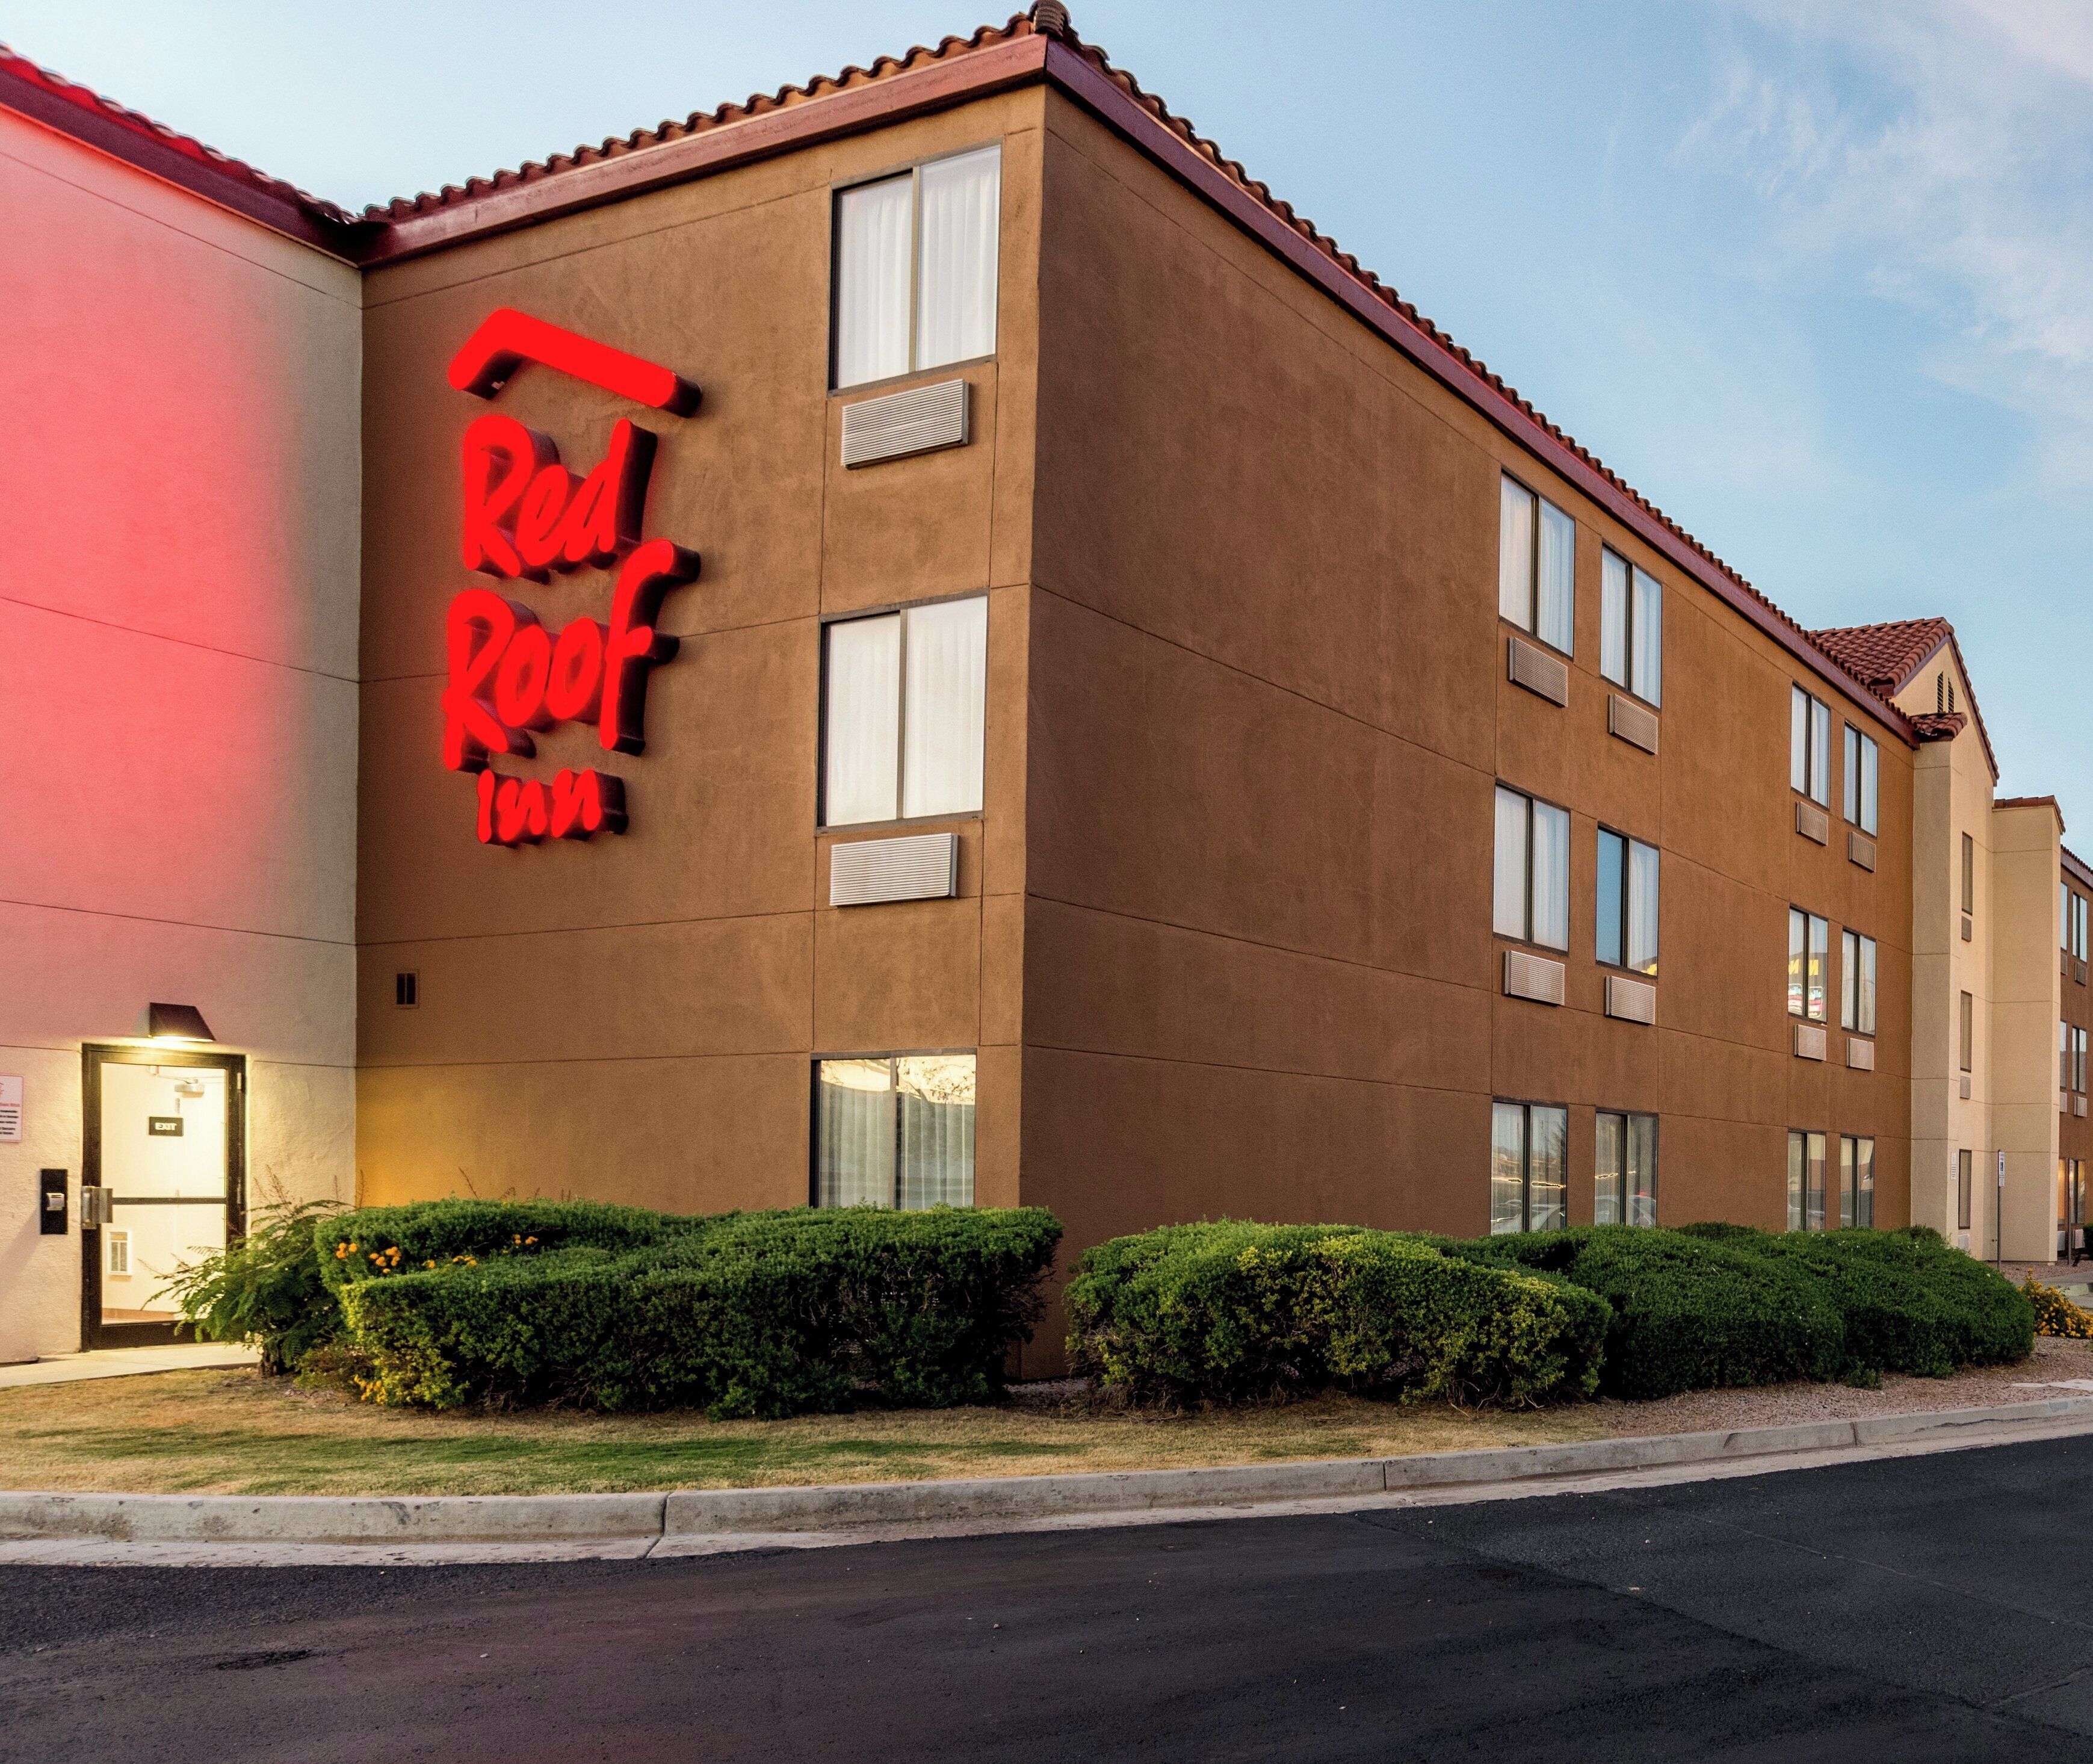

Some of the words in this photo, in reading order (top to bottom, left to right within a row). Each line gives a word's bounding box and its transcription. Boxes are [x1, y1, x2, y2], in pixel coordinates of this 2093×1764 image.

[462, 413, 635, 577] Red
[442, 537, 677, 772] Roof
[155, 1122, 177, 1131] EXIT
